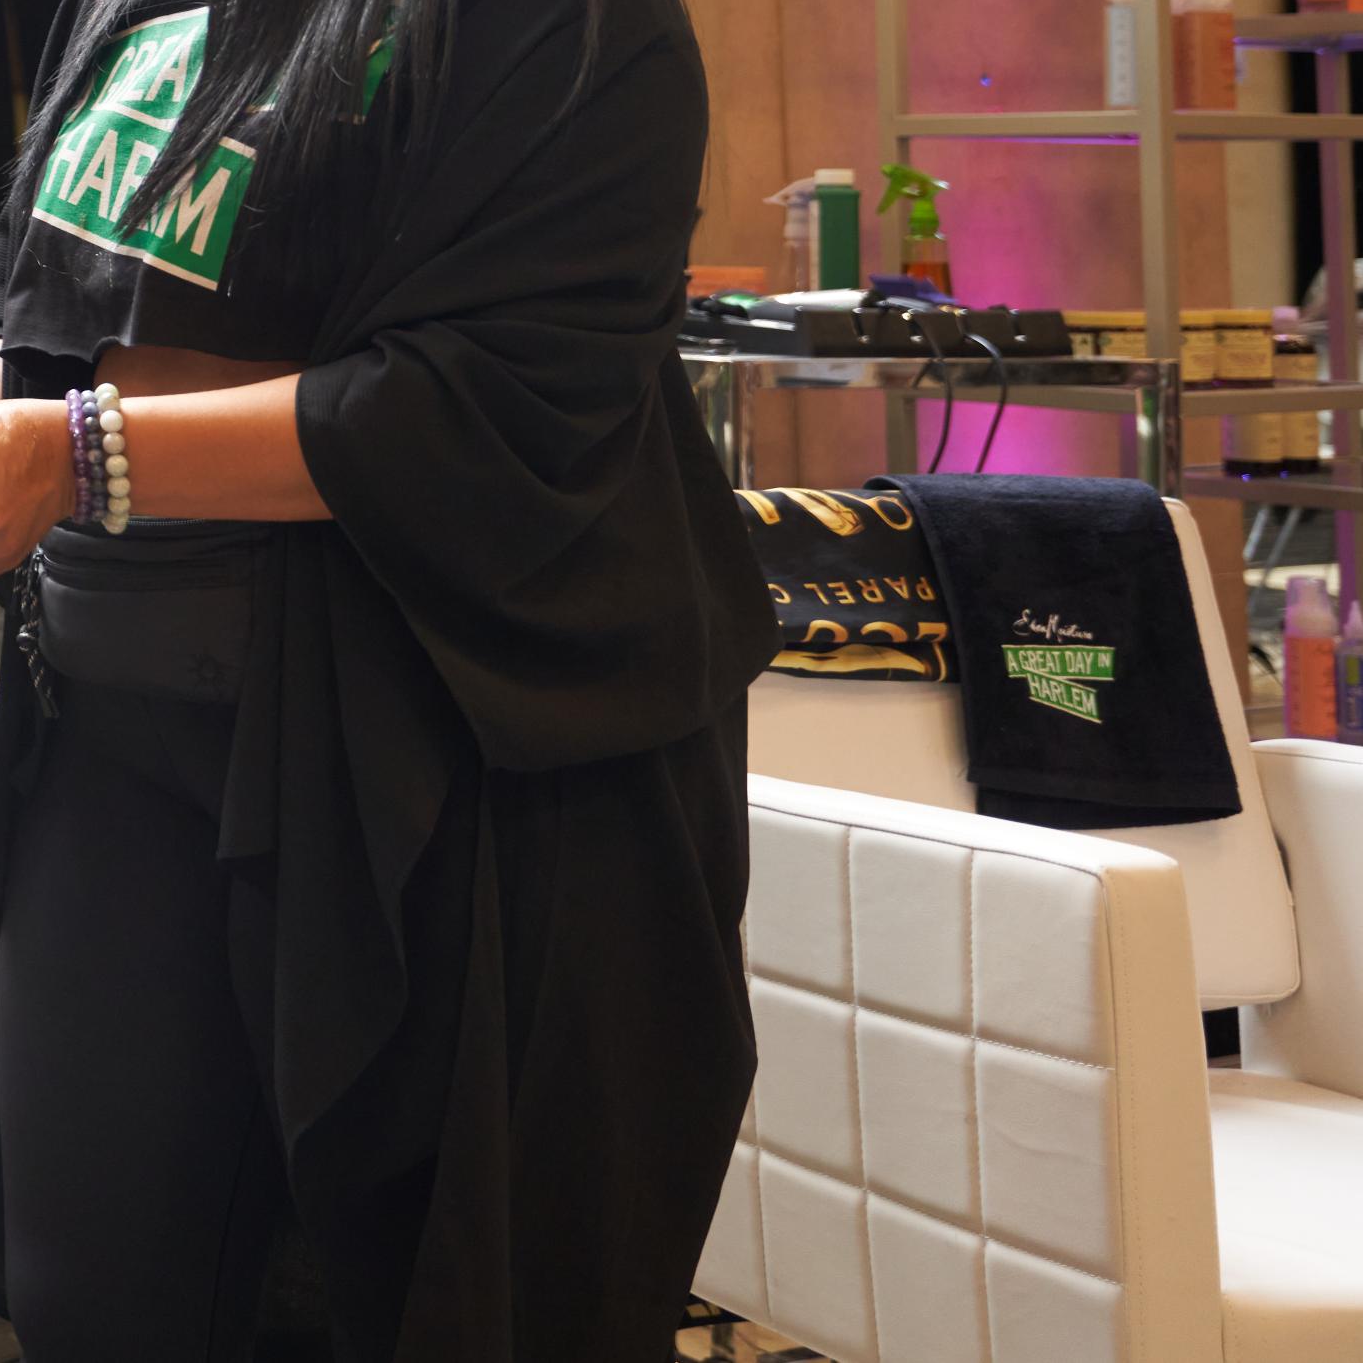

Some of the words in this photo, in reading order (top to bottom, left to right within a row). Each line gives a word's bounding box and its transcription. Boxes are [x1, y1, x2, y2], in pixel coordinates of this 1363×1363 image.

[95, 25, 201, 105] GREA
[45, 122, 232, 256] HARM
[803, 576, 936, 605] PAREL
[1007, 650, 1019, 672] A
[1019, 650, 1061, 673] GREAT
[1065, 651, 1094, 674] DAY
[1098, 652, 1111, 667] IN
[1027, 673, 1098, 716] HARLEM
